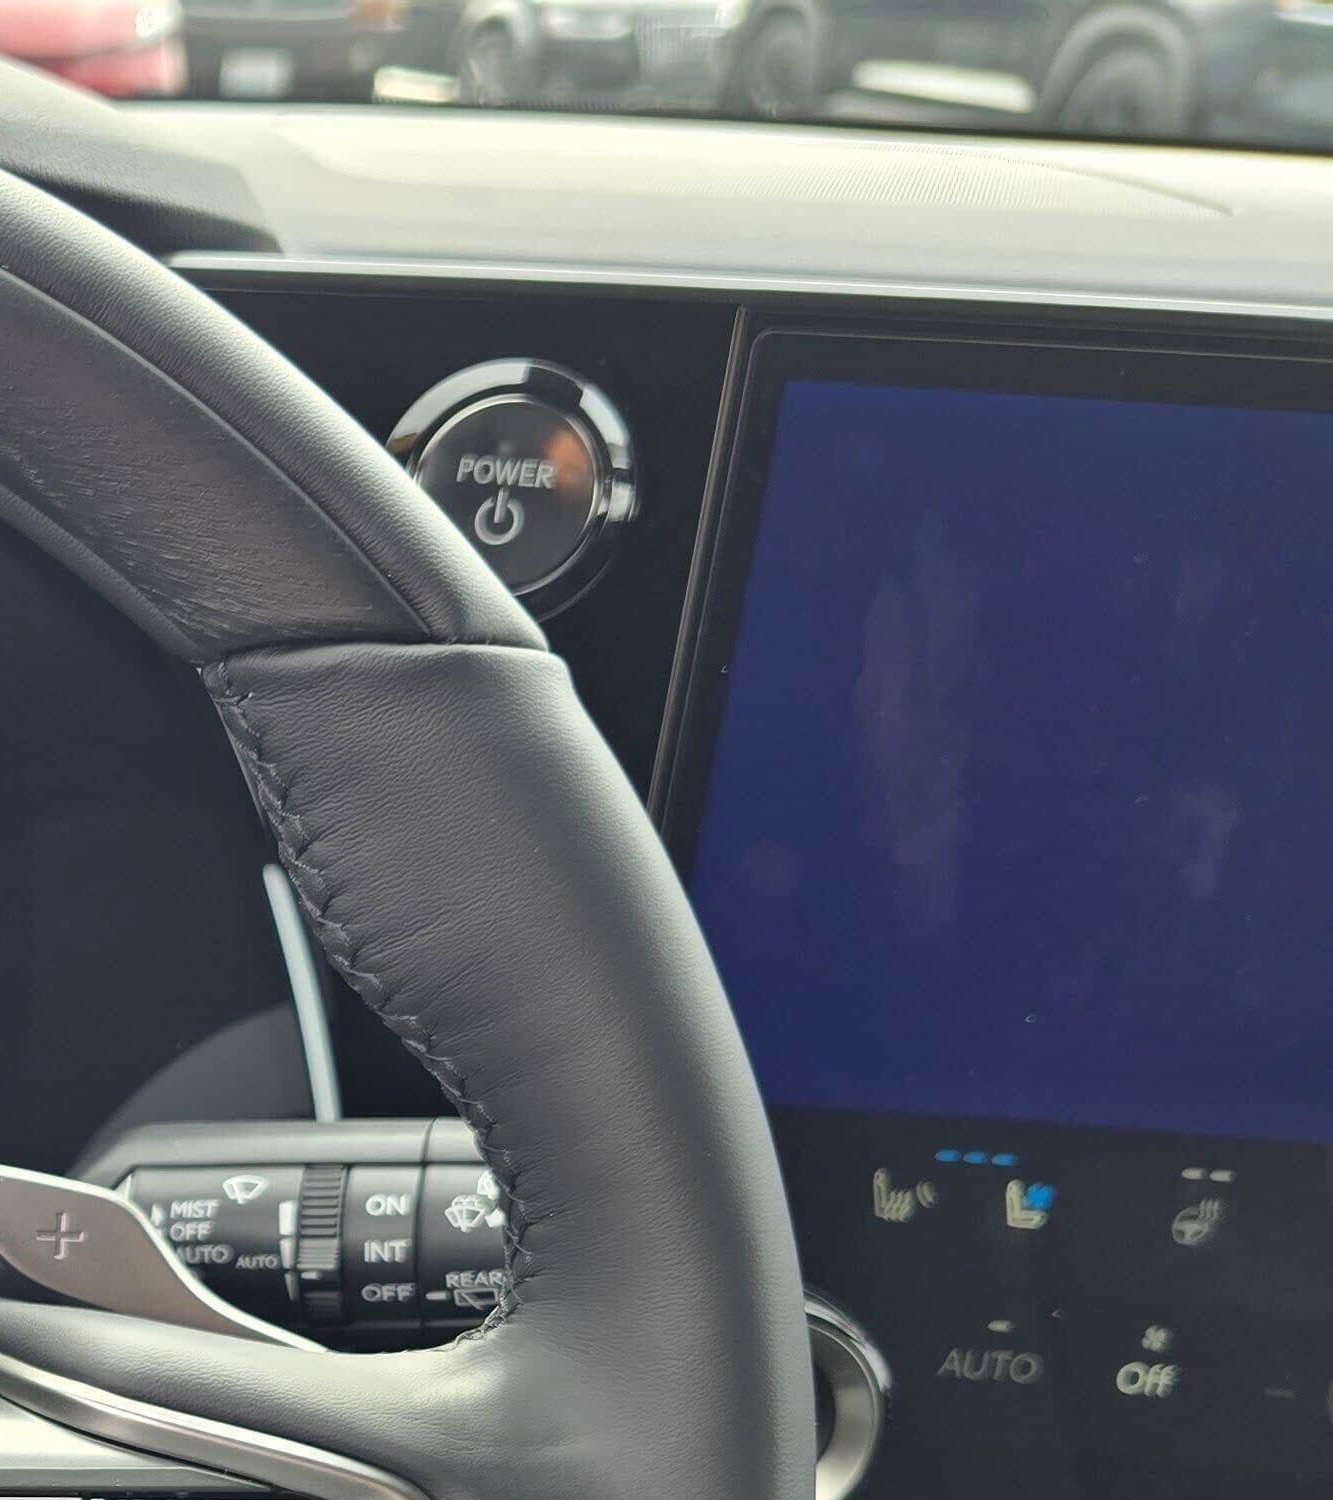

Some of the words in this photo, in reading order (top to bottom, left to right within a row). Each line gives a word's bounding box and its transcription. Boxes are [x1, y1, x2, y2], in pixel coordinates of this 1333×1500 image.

[456, 455, 557, 489] POWER
[169, 1199, 220, 1220] MIST
[364, 1193, 410, 1218] ON
[169, 1221, 212, 1242] OFF
[235, 1253, 279, 1269] AUTO
[364, 1239, 410, 1264] INT
[445, 1270, 505, 1289] REAR
[361, 1282, 417, 1303] OFF
[937, 1348, 1044, 1385] AUTO
[1115, 1360, 1181, 1398] Off
